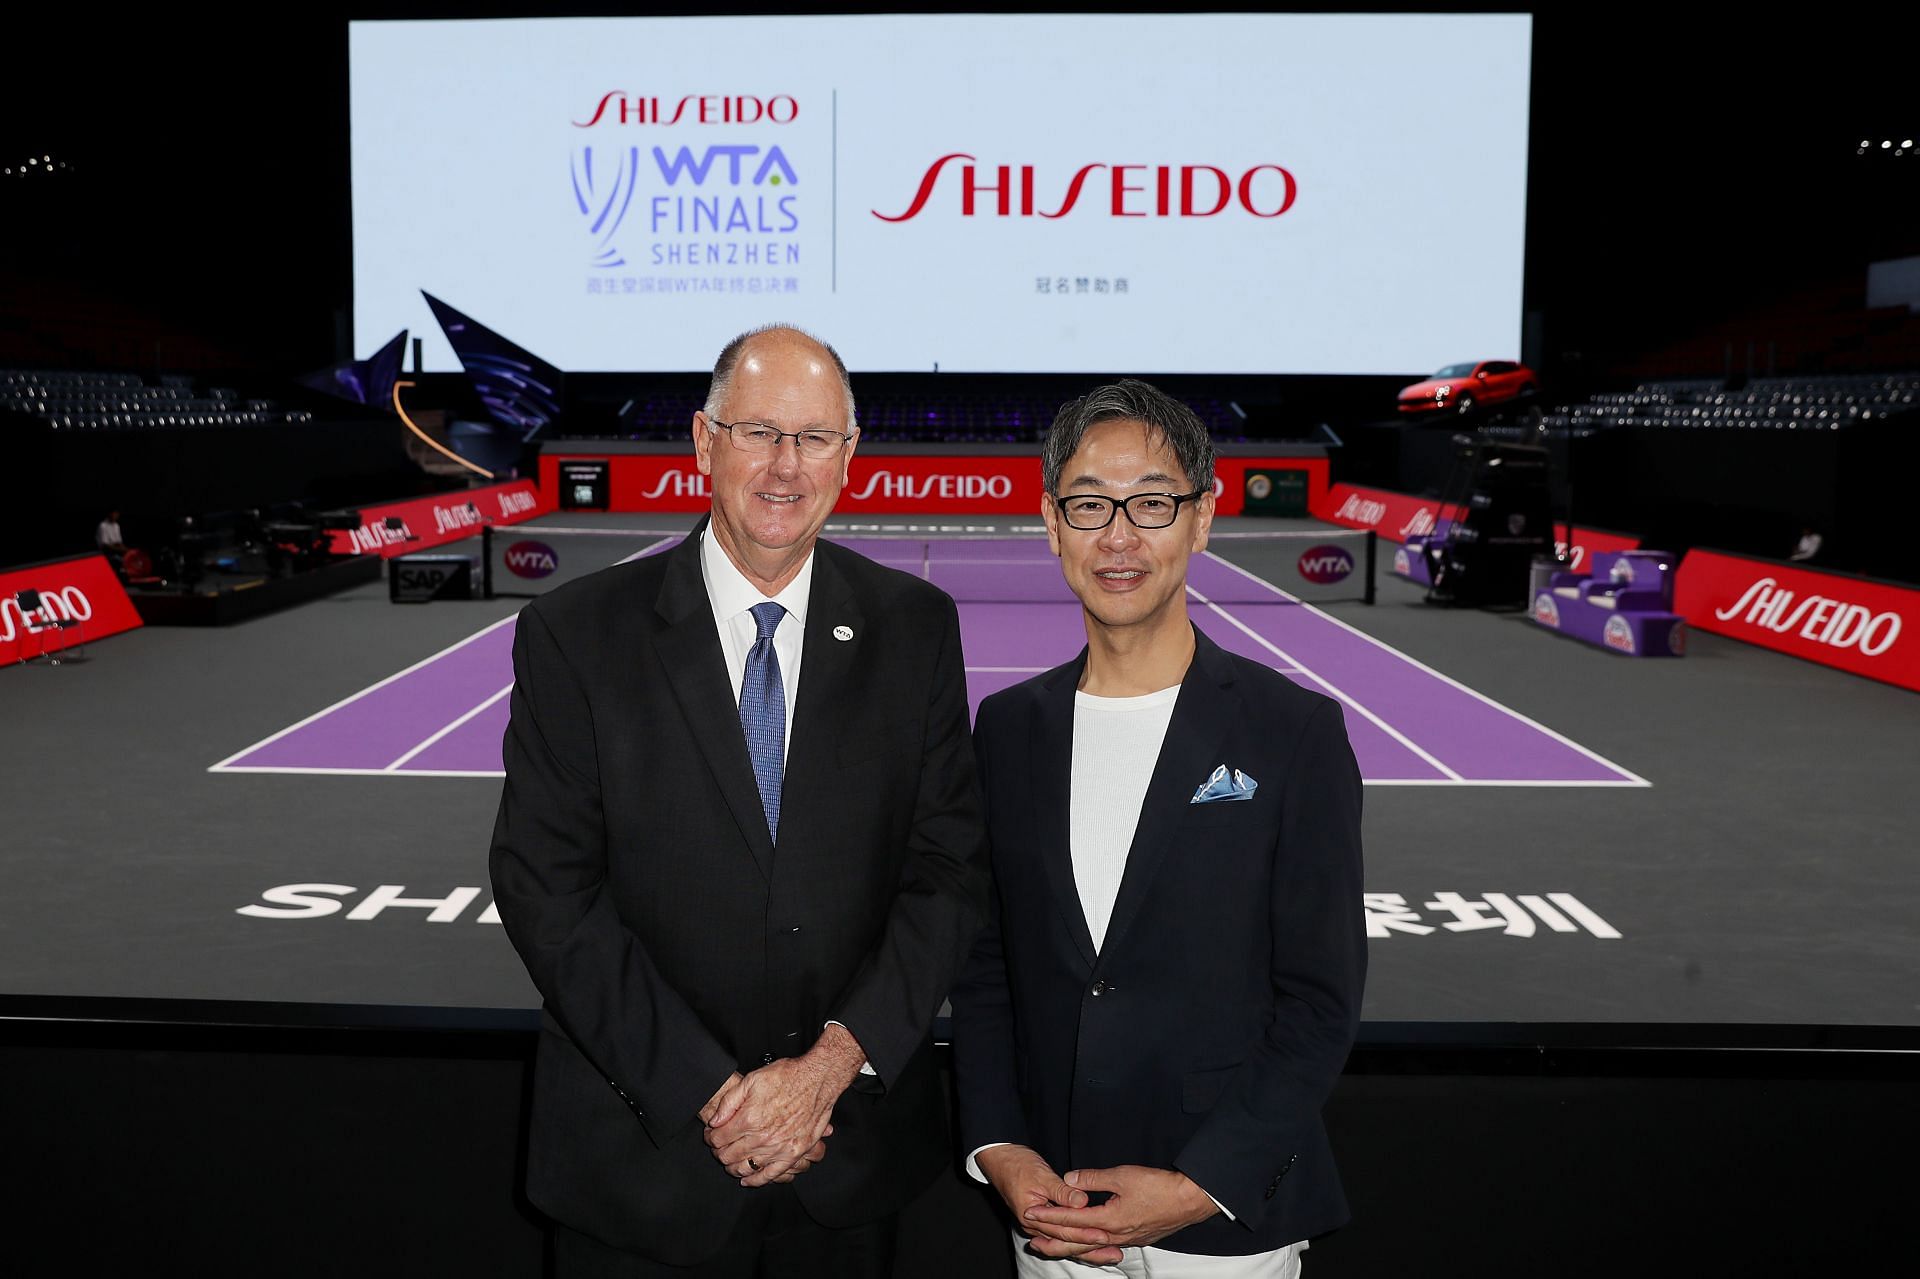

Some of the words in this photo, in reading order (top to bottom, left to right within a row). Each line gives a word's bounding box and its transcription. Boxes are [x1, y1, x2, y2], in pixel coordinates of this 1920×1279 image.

[571, 89, 799, 128] SHISEIDO
[652, 145, 798, 186] WTA
[871, 152, 1298, 223] SHISEIDO
[652, 196, 799, 233] FINALS
[652, 243, 799, 265] SHENZHEN
[1035, 277, 1129, 294] 冠名赞助商
[850, 470, 1012, 500] SHISEIDO
[506, 549, 558, 571] WTA
[1300, 556, 1351, 575] WTA
[400, 569, 445, 591] SAP
[1715, 577, 1902, 657] SHISEIDO
